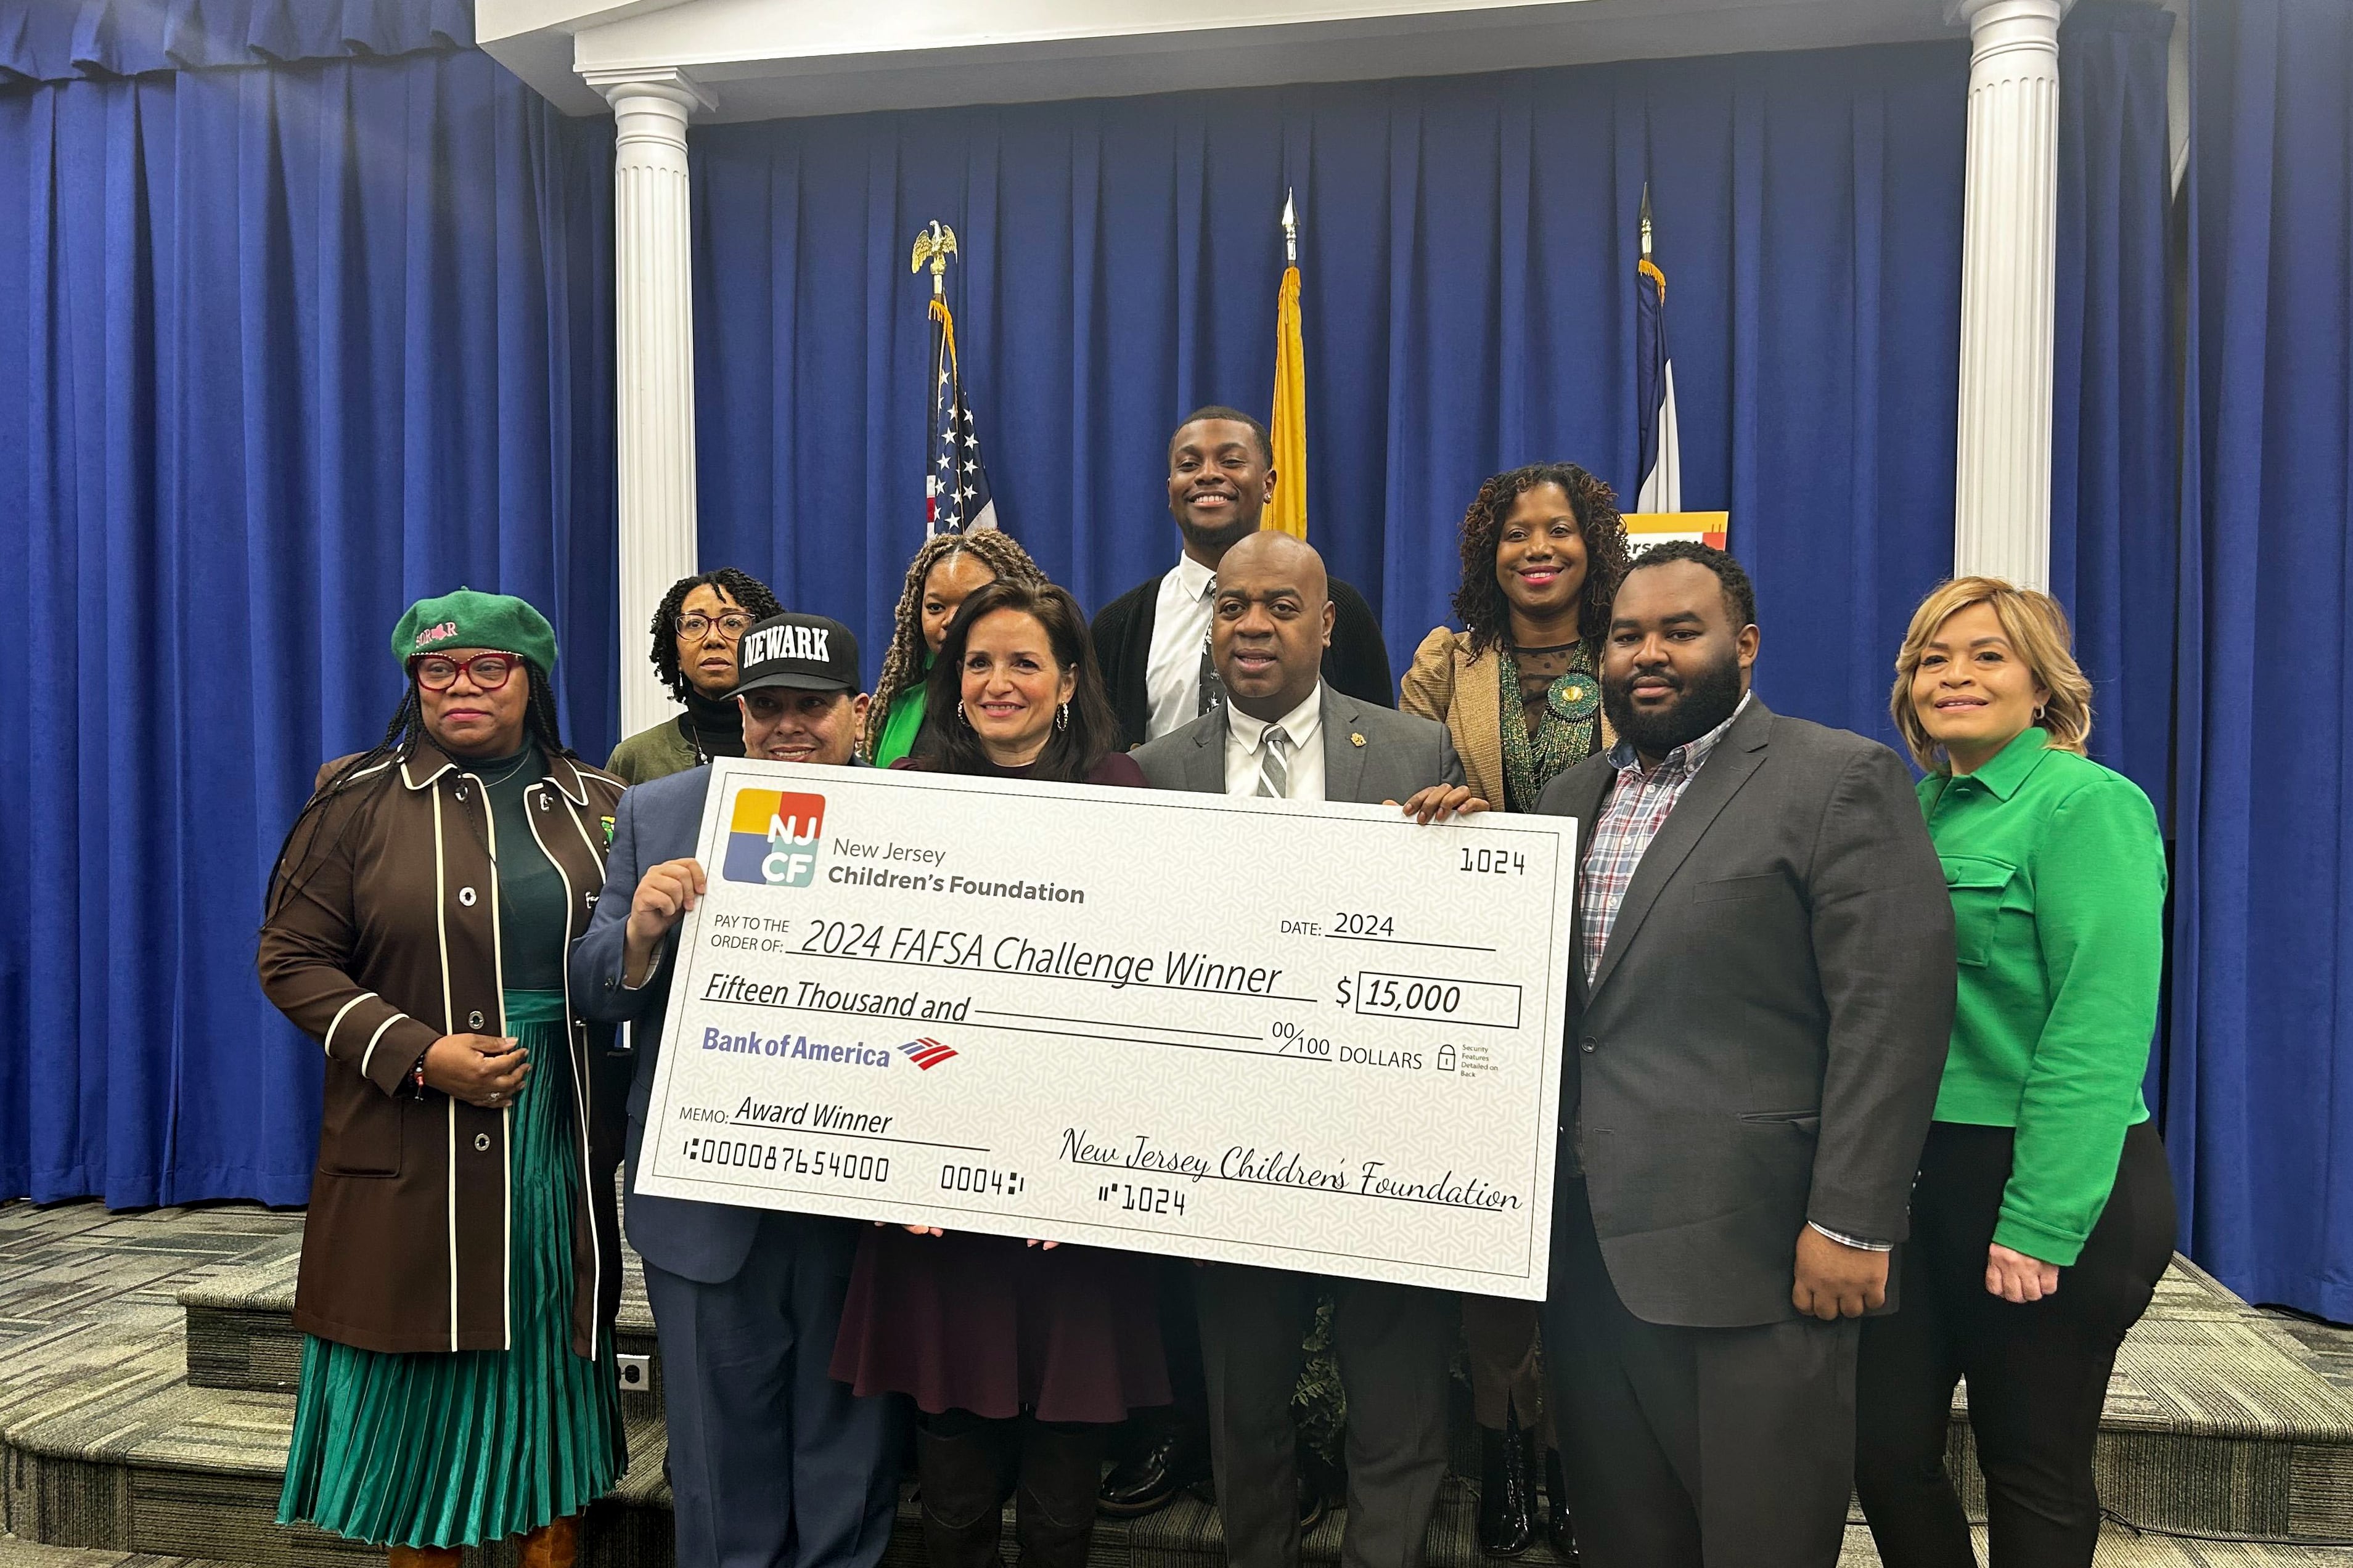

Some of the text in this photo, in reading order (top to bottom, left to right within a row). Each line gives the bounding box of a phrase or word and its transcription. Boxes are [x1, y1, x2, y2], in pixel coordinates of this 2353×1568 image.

[743, 624, 830, 669] NEWARK
[767, 813, 817, 846] NJ
[761, 851, 813, 883] CF
[833, 838, 946, 867] New Jersey
[1460, 848, 1525, 875] 1024
[828, 865, 1085, 904] Children's Foundation
[714, 914, 789, 933] PAY TO THE
[1280, 912, 1394, 937] DATE: 2024
[711, 934, 784, 953] ORDER OF:
[801, 919, 1282, 994] 2024 FAFSA Challenge Winner
[705, 973, 971, 1022] Fifteen Thousand and
[1365, 979, 1461, 1014] 15,000
[702, 1027, 891, 1069] Bank of America
[1340, 1045, 1423, 1071] DOLLARS
[1462, 1044, 1488, 1053] Security
[1462, 1053, 1489, 1061] Features
[1461, 1061, 1488, 1070] Detailed
[679, 1096, 893, 1134] MEMO: Award Winner
[1059, 1127, 1523, 1210] New Jersey Children's Foundation
